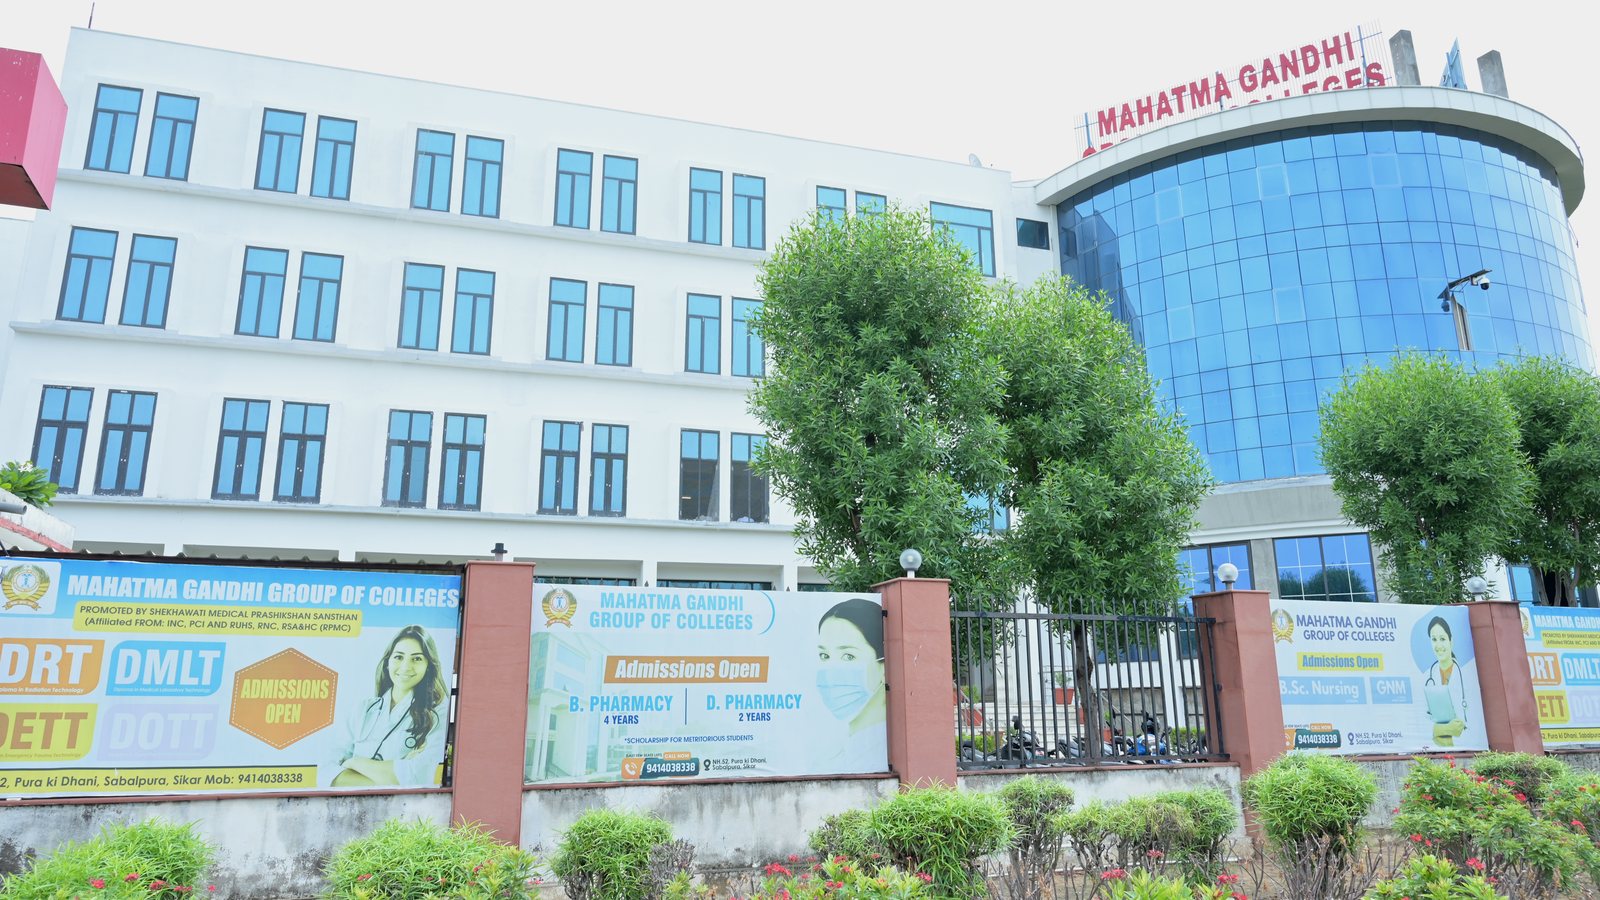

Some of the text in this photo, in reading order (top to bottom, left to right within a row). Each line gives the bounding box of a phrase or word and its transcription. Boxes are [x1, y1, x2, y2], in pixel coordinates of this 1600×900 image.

[1098, 72, 1232, 137] MAHATMA
[1239, 32, 1354, 92] GANDHI
[67, 575, 460, 608] MAHATMA GANDHI GROUP OF COLLEGES
[600, 592, 743, 611] MAHATMA GANDHI
[80, 606, 358, 621] PROMOTED BY SHEKHAWATI MEDICAL PRASHIKSHAN SANSTHAN
[590, 612, 753, 630] GROUP OF COLLEGES
[1296, 614, 1397, 629] MAHATMA GANDHI
[1575, 616, 1600, 628] GANDH
[85, 617, 132, 627] (Affiliated
[135, 619, 165, 627] FROM:
[167, 620, 186, 628] INC,
[230, 622, 255, 630] RUHS,
[258, 622, 279, 630] RNC,
[282, 623, 317, 631] RSA&HC
[320, 623, 351, 632] (RPMC)
[1303, 630, 1395, 642] GROUP OF COLLEGES
[0, 644, 92, 684] DRT
[115, 648, 220, 685] DMLT
[615, 660, 760, 680] Admissions Open
[1302, 655, 1379, 669] Admissions Open
[1563, 658, 1600, 680] DMLT
[241, 679, 329, 699] ADMISSIONS
[1280, 680, 1359, 698] B.Sc. Nursing
[1377, 681, 1406, 694] GNM
[570, 695, 673, 712] B. PHARMACY
[707, 694, 802, 710] D. PHARMACY
[1538, 696, 1565, 717] ETT
[266, 704, 301, 724] OPEN
[604, 715, 639, 724] 4 YEARS
[739, 712, 771, 722] 2 YEARS
[110, 712, 213, 749] DOTT
[1298, 734, 1338, 744] 9414038338
[646, 762, 695, 773] 9414038338
[15, 778, 42, 787] Pura
[47, 777, 57, 787] ki
[61, 776, 99, 787] Dhani,
[104, 776, 169, 787] Sabalpura,
[173, 775, 201, 785] Sikar
[205, 774, 234, 785] Mob:
[238, 774, 302, 783] 9414038338
